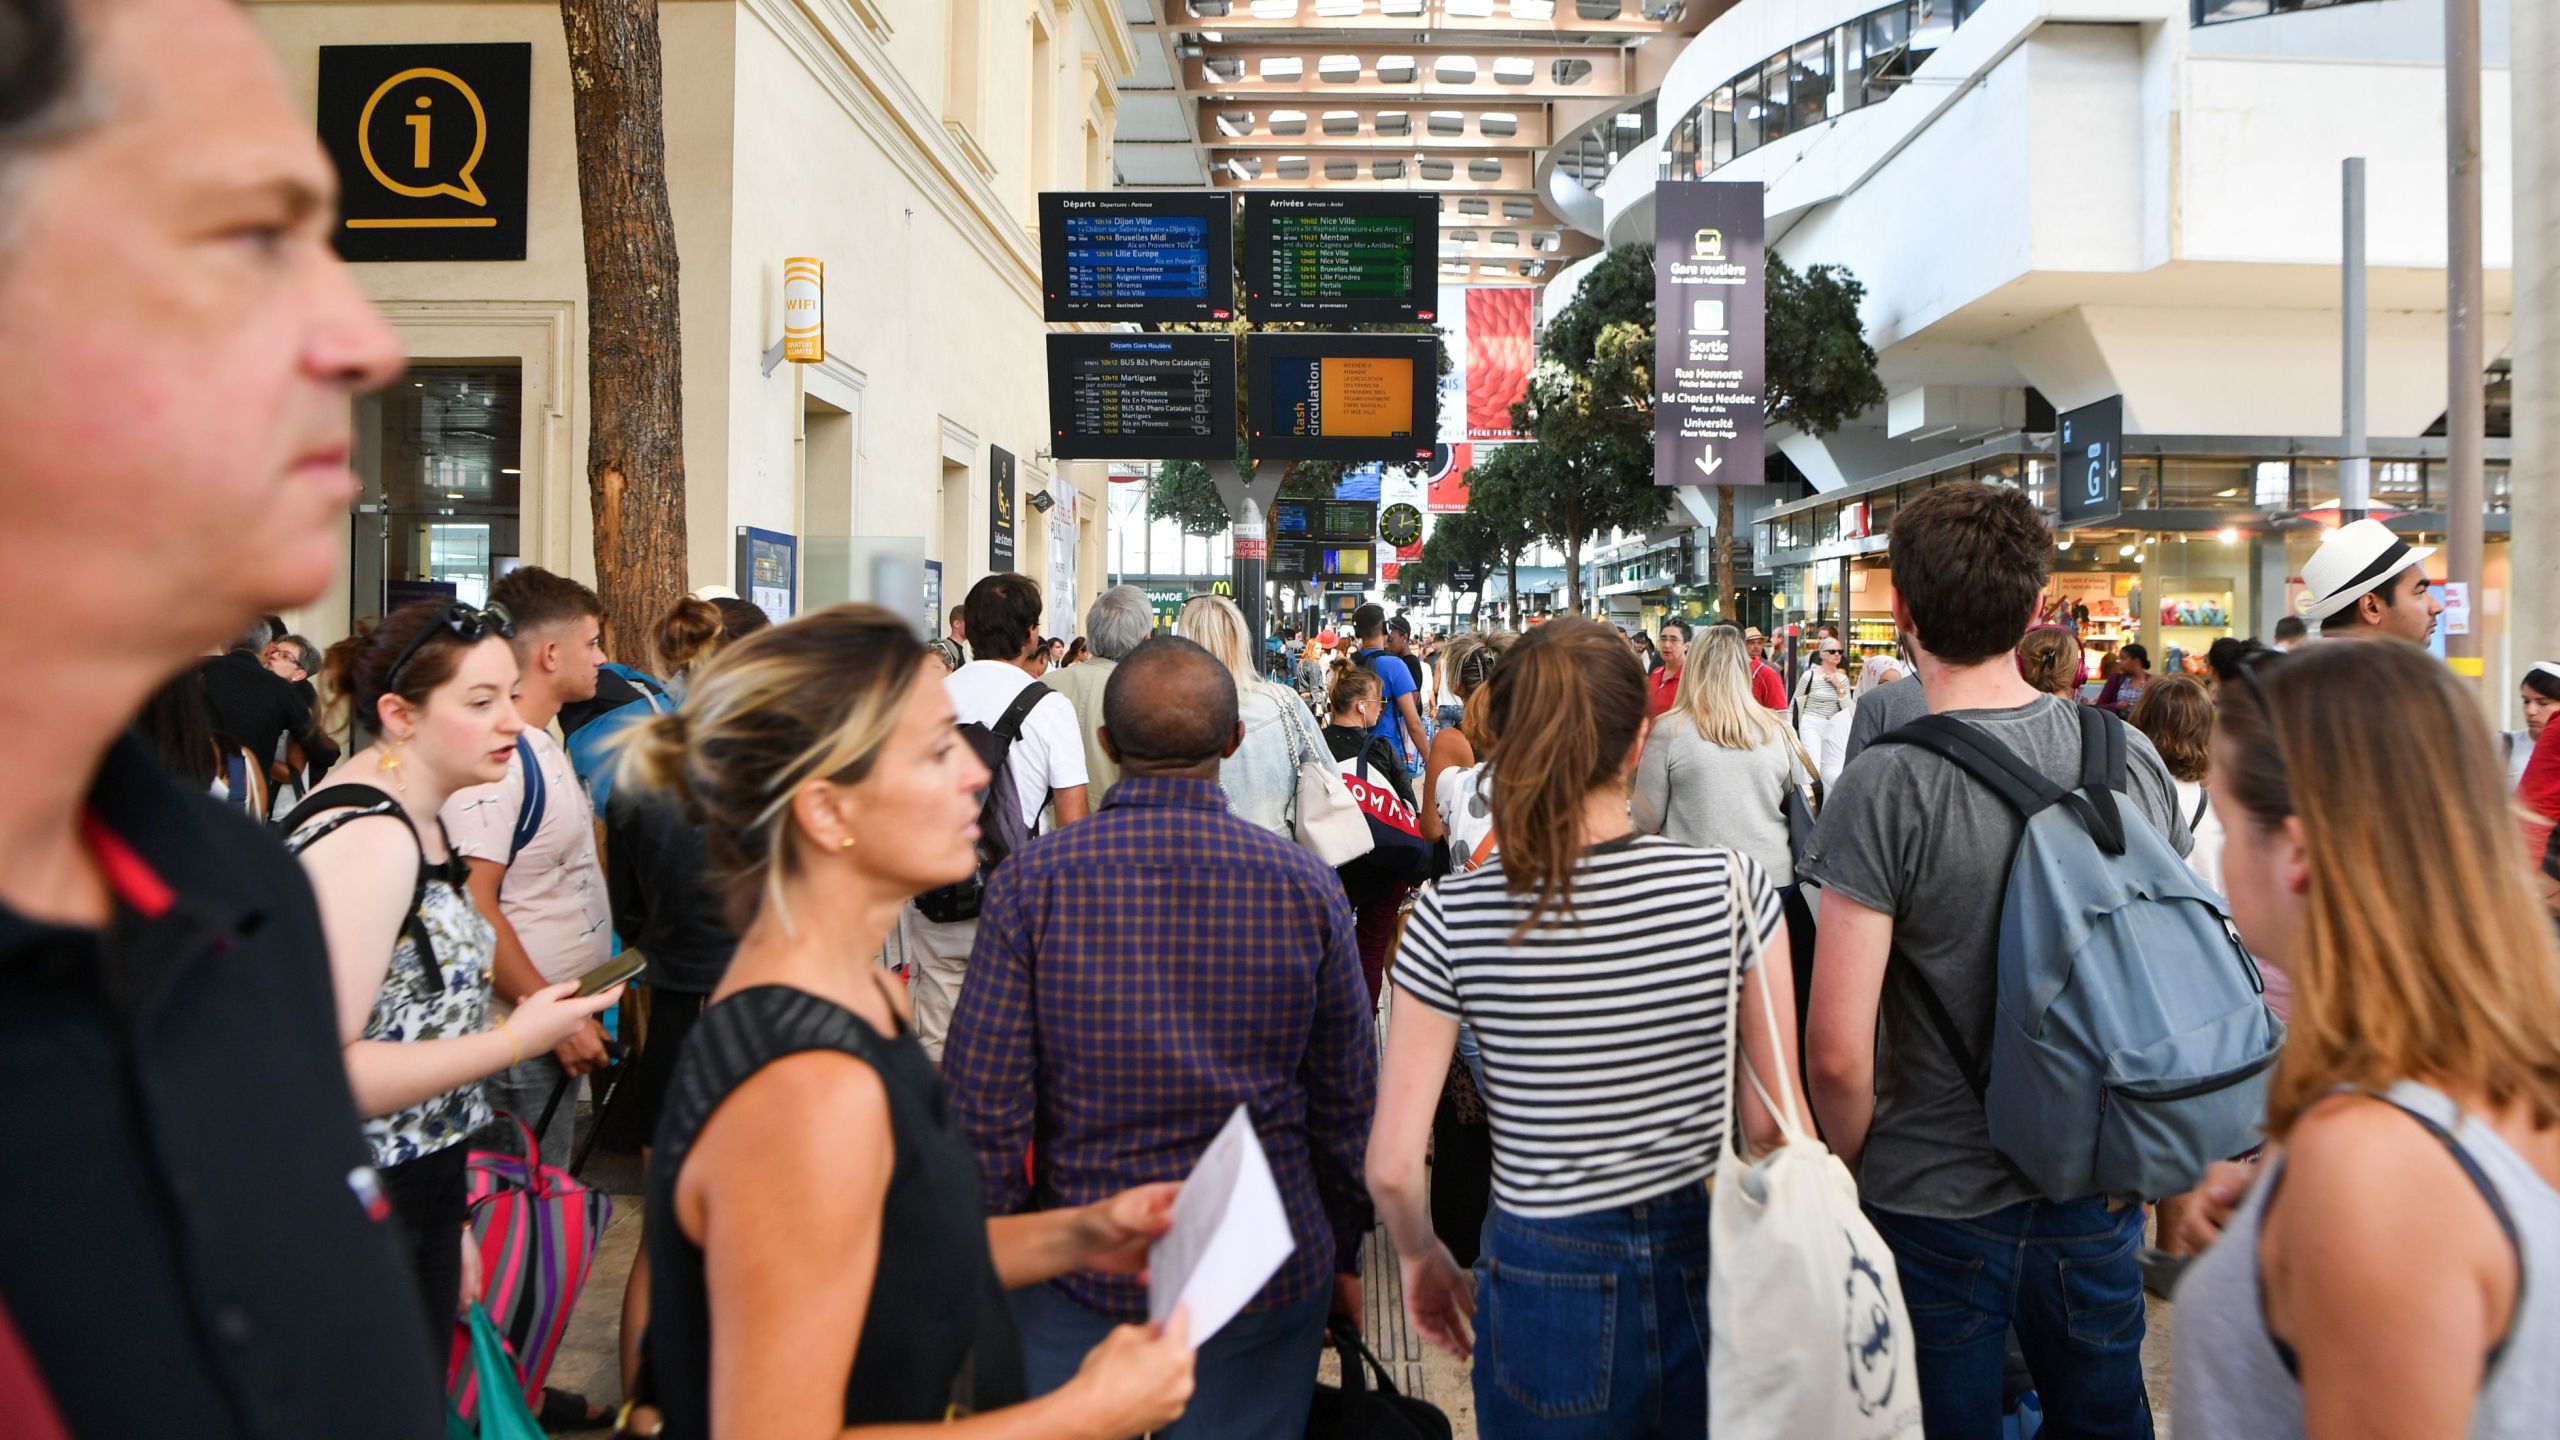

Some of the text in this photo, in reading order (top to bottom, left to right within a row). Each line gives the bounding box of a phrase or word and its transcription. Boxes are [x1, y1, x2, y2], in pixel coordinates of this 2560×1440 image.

[1063, 200, 1096, 208] Départs
[1115, 218, 1133, 226] Dijon
[1133, 251, 1159, 259] Europe
[1671, 262, 1746, 275] Gare routière
[786, 299, 816, 310] WIFI
[1689, 339, 1728, 353] Sortie
[1121, 375, 1157, 383] Martigues
[1675, 368, 1743, 379] Rue Honnorat
[1191, 369, 1209, 435] départs
[1308, 362, 1319, 436] circulation
[1662, 392, 1756, 404] Bd Charles Nedelec
[1691, 405, 1708, 413] Porte
[1293, 402, 1305, 435] flash
[1684, 418, 1734, 428] Université
[1719, 430, 1737, 439] Hugo
[2088, 461, 2100, 496] G
